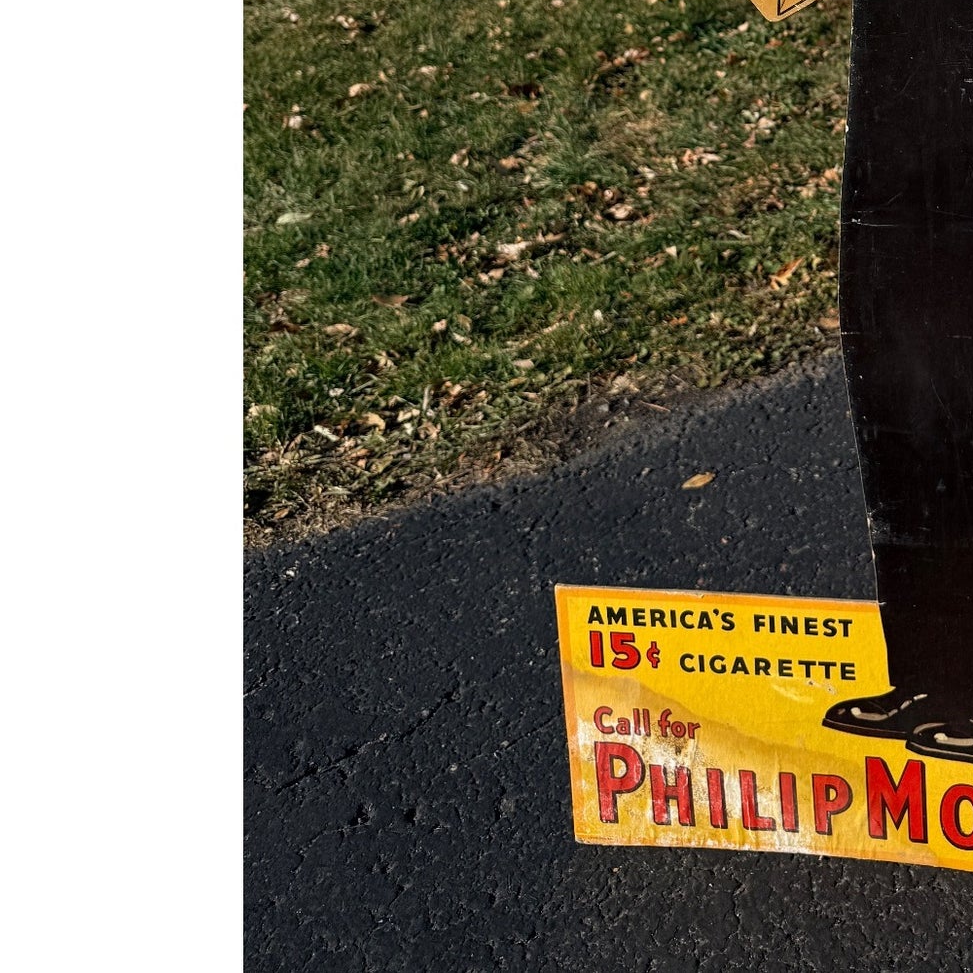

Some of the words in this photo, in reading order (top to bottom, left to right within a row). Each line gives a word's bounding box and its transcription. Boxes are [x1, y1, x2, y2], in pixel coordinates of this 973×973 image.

[588, 605, 735, 631] AMERICA'S
[753, 613, 853, 637] FINEST
[589, 630, 661, 670] 15¢
[679, 653, 856, 681] CIGARETTE
[593, 705, 650, 737] Call
[657, 708, 700, 740] for
[594, 740, 853, 837] PHILIP
